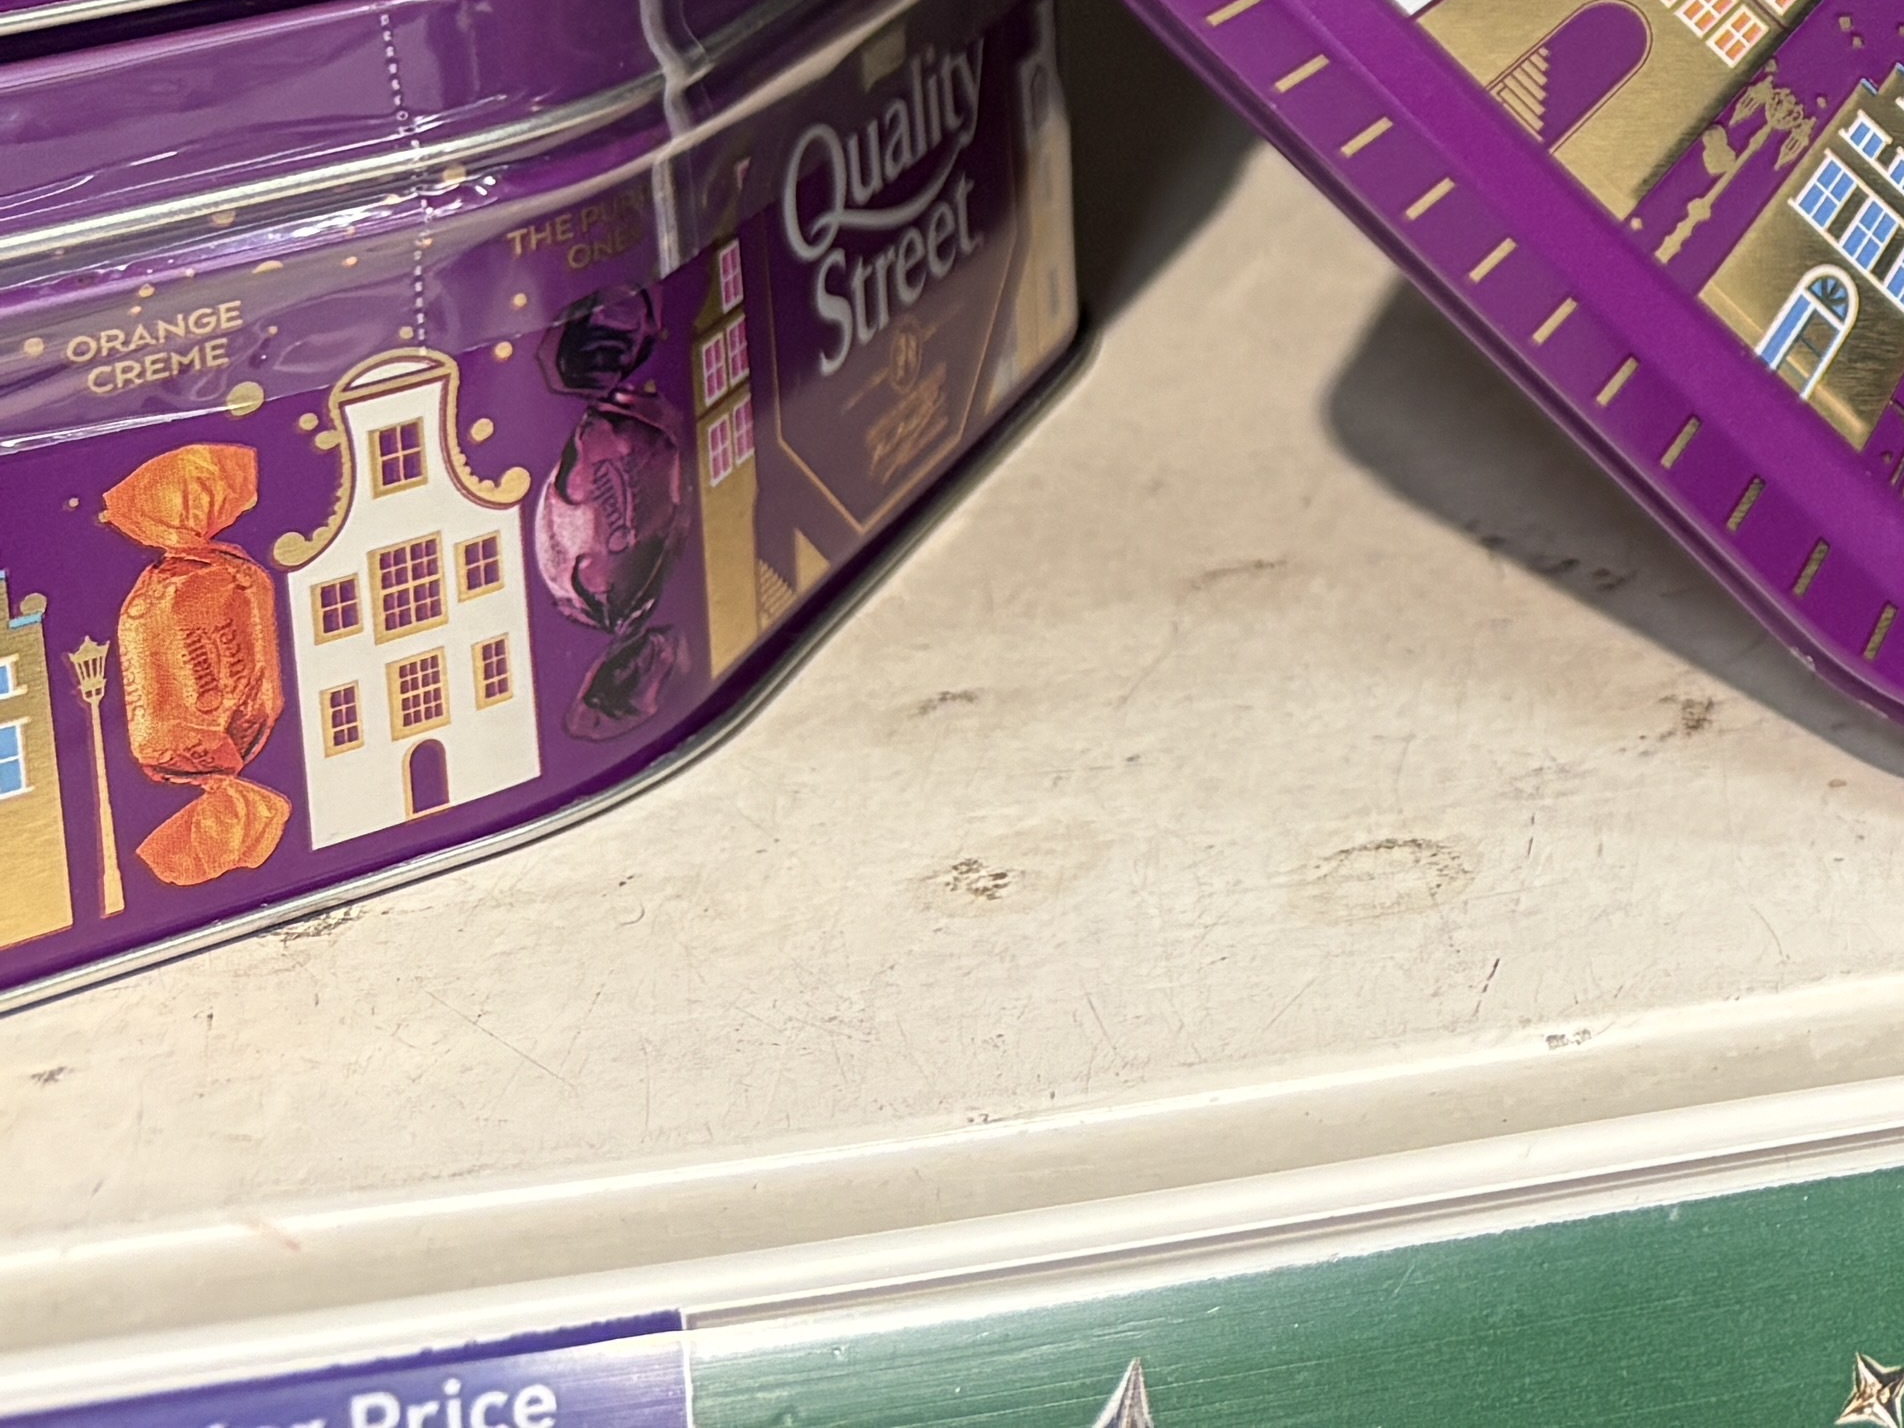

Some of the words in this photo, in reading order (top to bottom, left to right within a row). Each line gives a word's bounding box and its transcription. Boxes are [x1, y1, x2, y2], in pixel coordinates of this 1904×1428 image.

[784, 36, 984, 263] Quality
[507, 212, 575, 259] THE
[817, 170, 977, 377] Street
[66, 300, 243, 363] ORANGE
[87, 337, 230, 394] CREME
